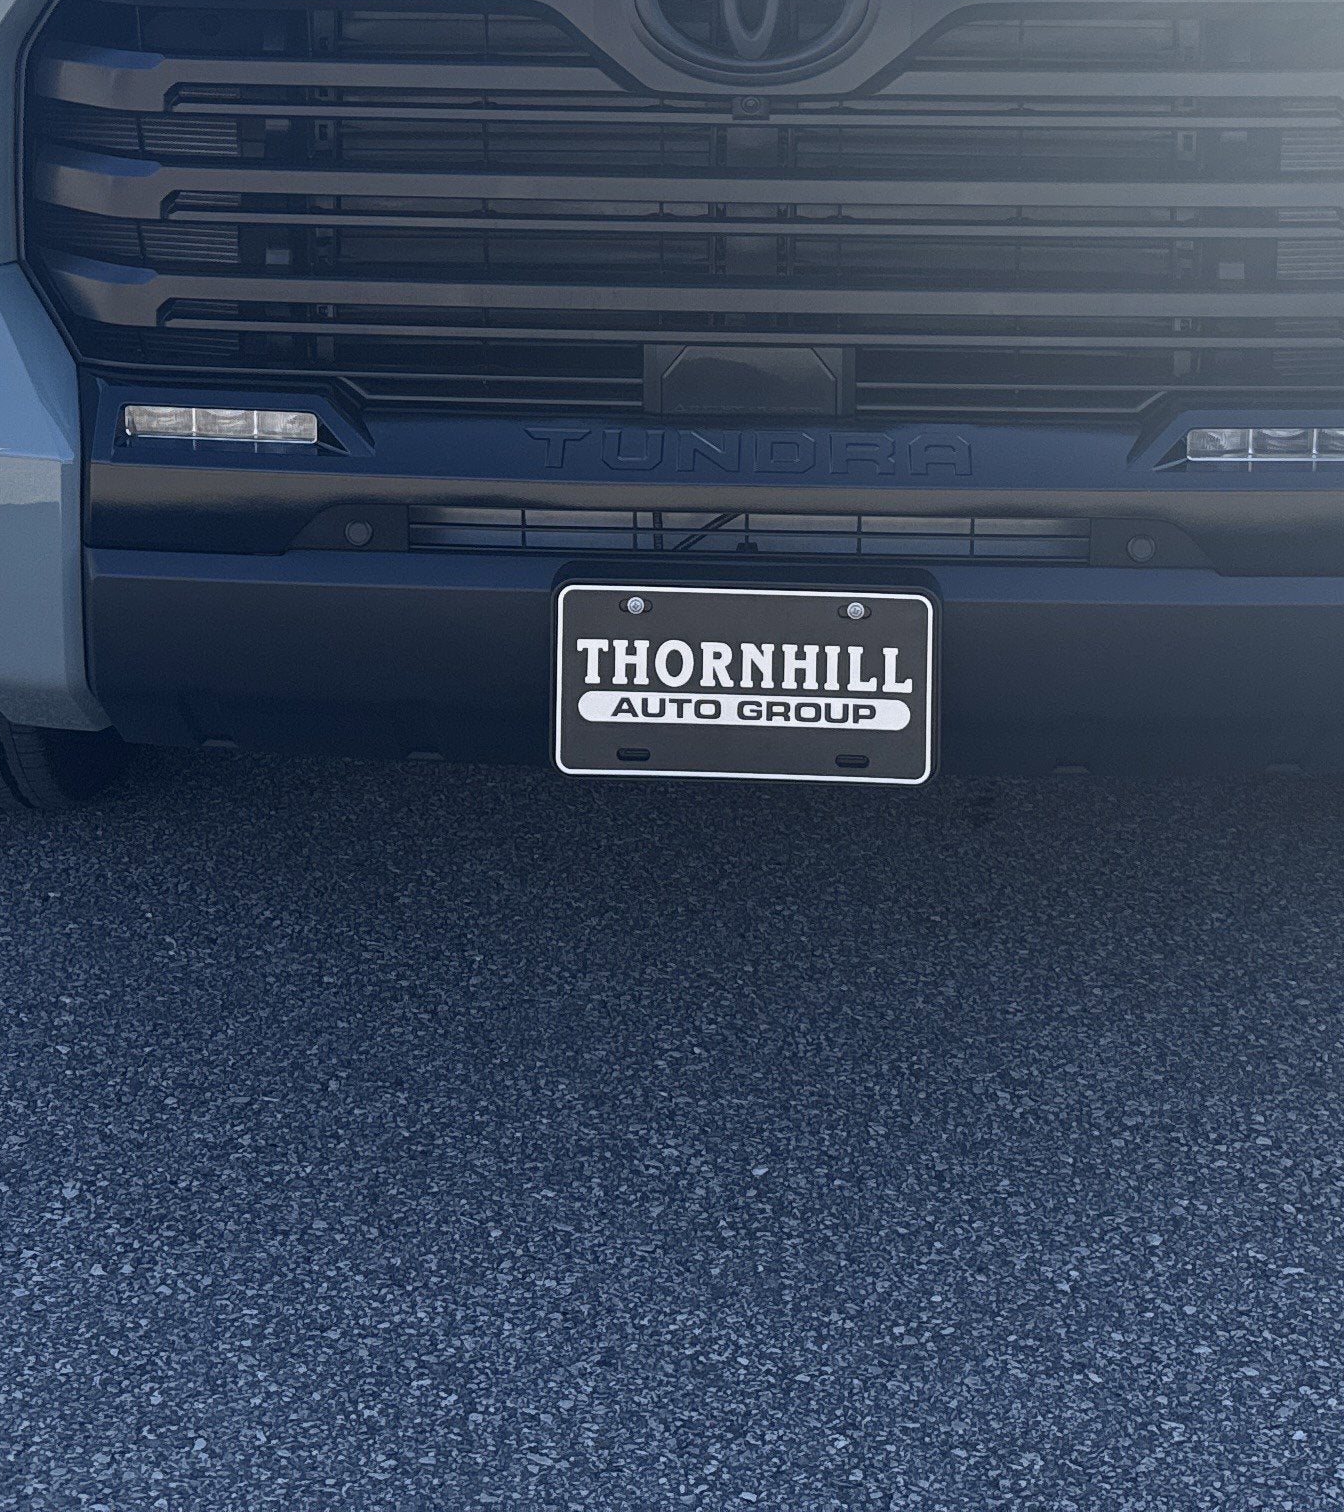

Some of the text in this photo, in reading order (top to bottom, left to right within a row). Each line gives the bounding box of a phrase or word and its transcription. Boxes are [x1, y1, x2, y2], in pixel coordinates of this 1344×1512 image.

[523, 427, 974, 477] TUNDRA
[576, 638, 913, 694] THORNHILL
[610, 696, 878, 725] AUTO GROUP
